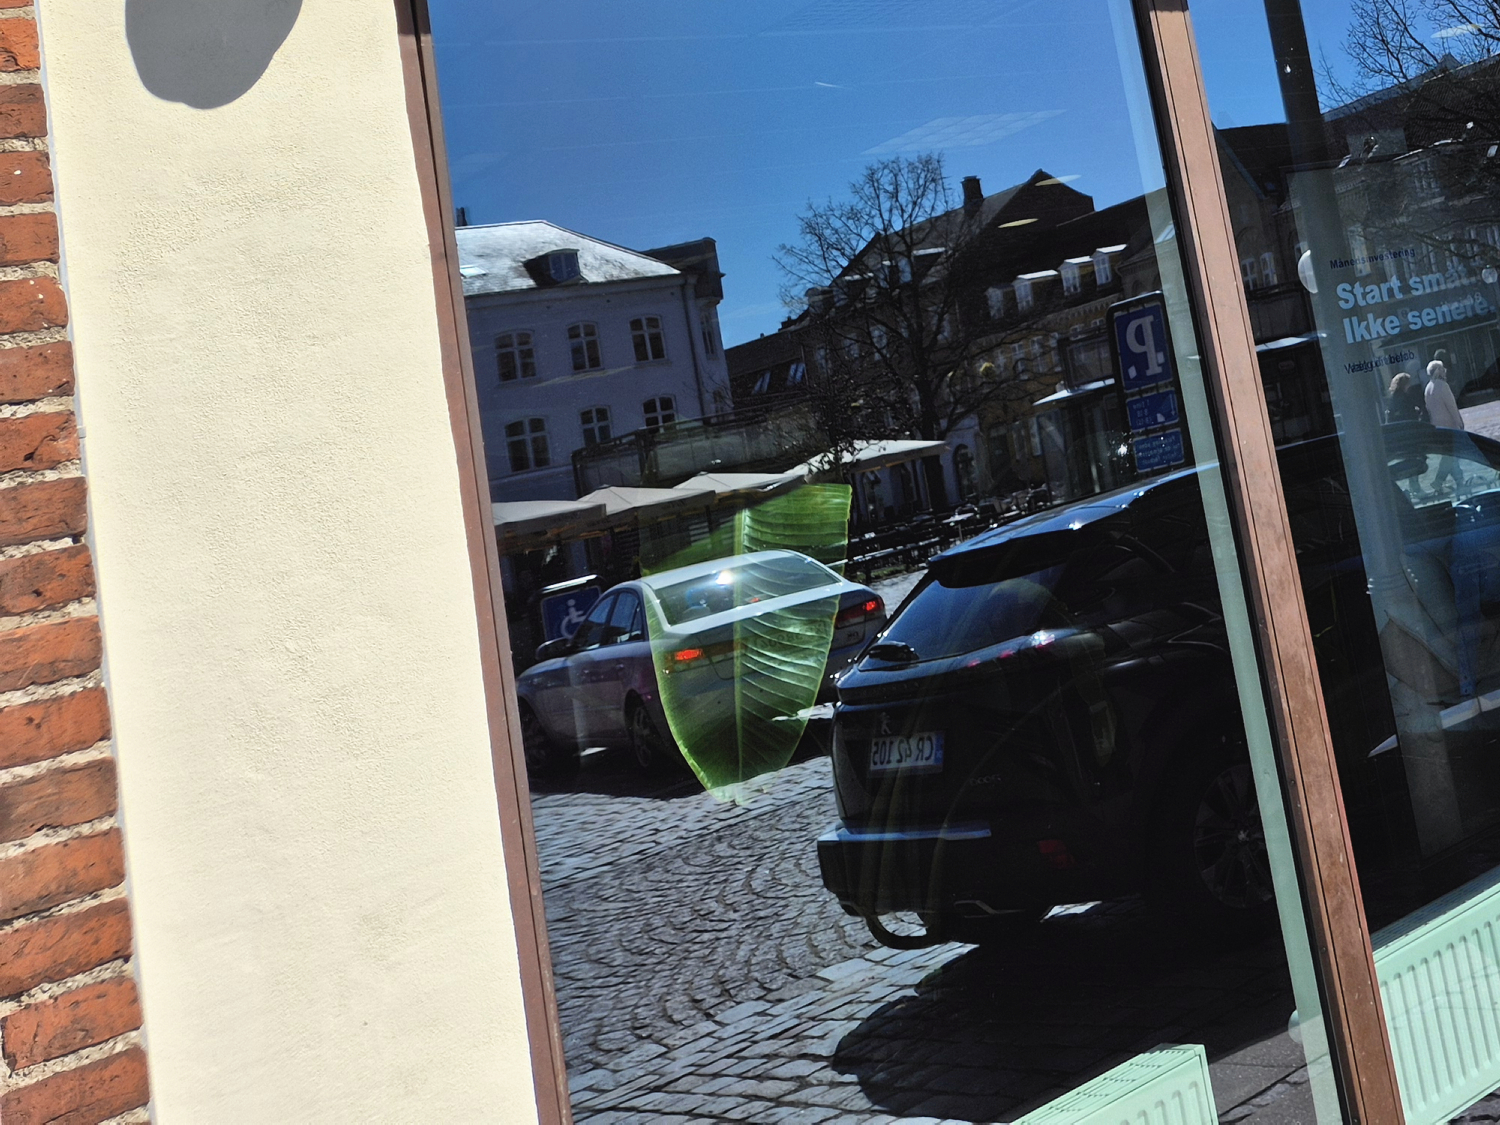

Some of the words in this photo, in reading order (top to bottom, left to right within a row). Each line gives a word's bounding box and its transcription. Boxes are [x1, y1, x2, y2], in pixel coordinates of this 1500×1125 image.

[1329, 247, 1416, 270] Månedsinvestering
[1336, 274, 1404, 310] Start
[1342, 313, 1401, 344] Ikke
[1407, 298, 1496, 331] senere.
